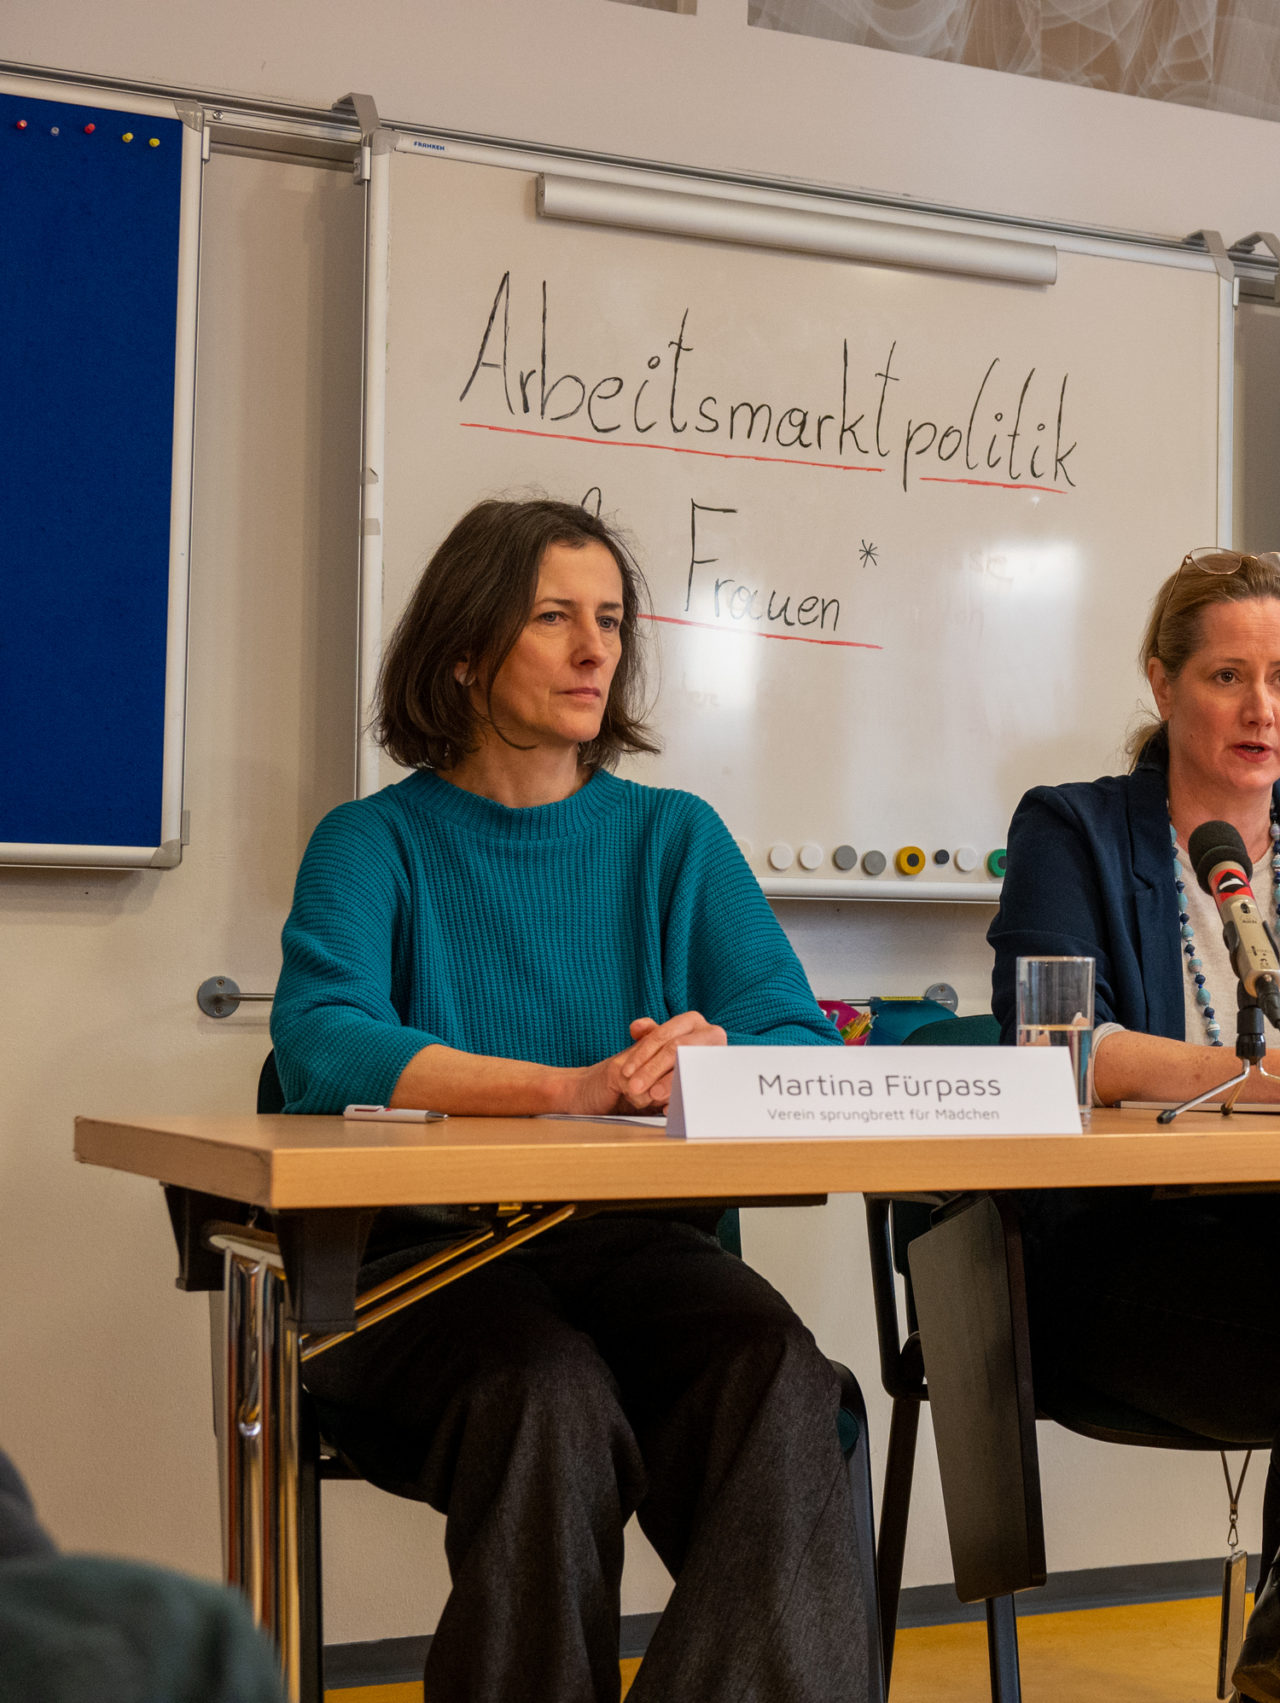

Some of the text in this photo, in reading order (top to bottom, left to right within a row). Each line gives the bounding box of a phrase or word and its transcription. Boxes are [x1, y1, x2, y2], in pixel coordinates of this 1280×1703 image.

[413, 141, 445, 151] FRANKEN
[460, 270, 1077, 492] Arbeitsmarktpolitik
[758, 1074, 1001, 1102] Martina Fürpass
[767, 1108, 1000, 1123] Verein sprungbrett für Mädchen
